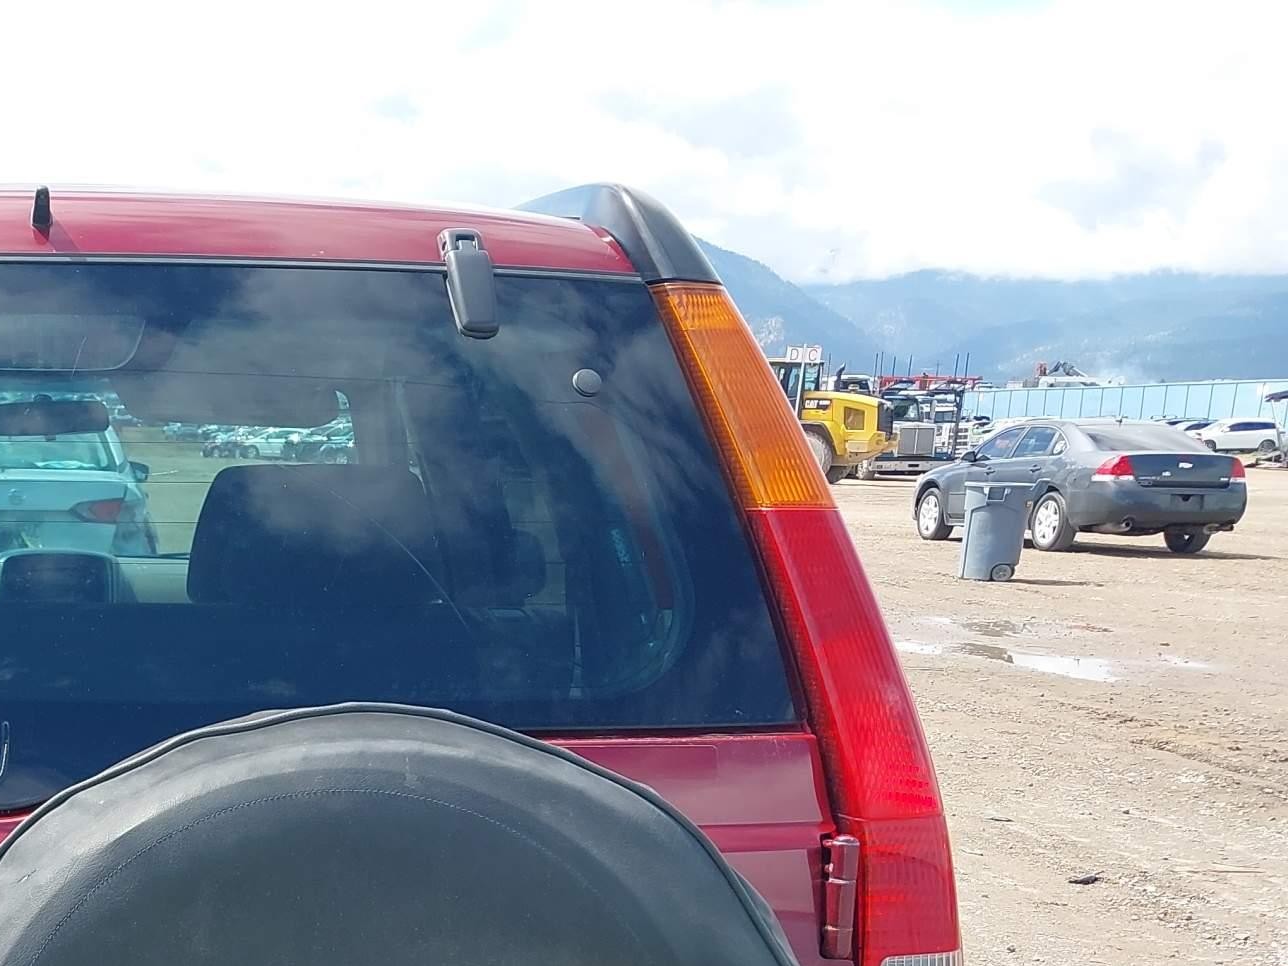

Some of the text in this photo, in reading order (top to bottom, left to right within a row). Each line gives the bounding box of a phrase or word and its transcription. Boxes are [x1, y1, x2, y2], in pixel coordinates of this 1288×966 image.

[789, 348, 799, 361] D
[808, 348, 818, 362] C
[805, 400, 819, 409] CAT
